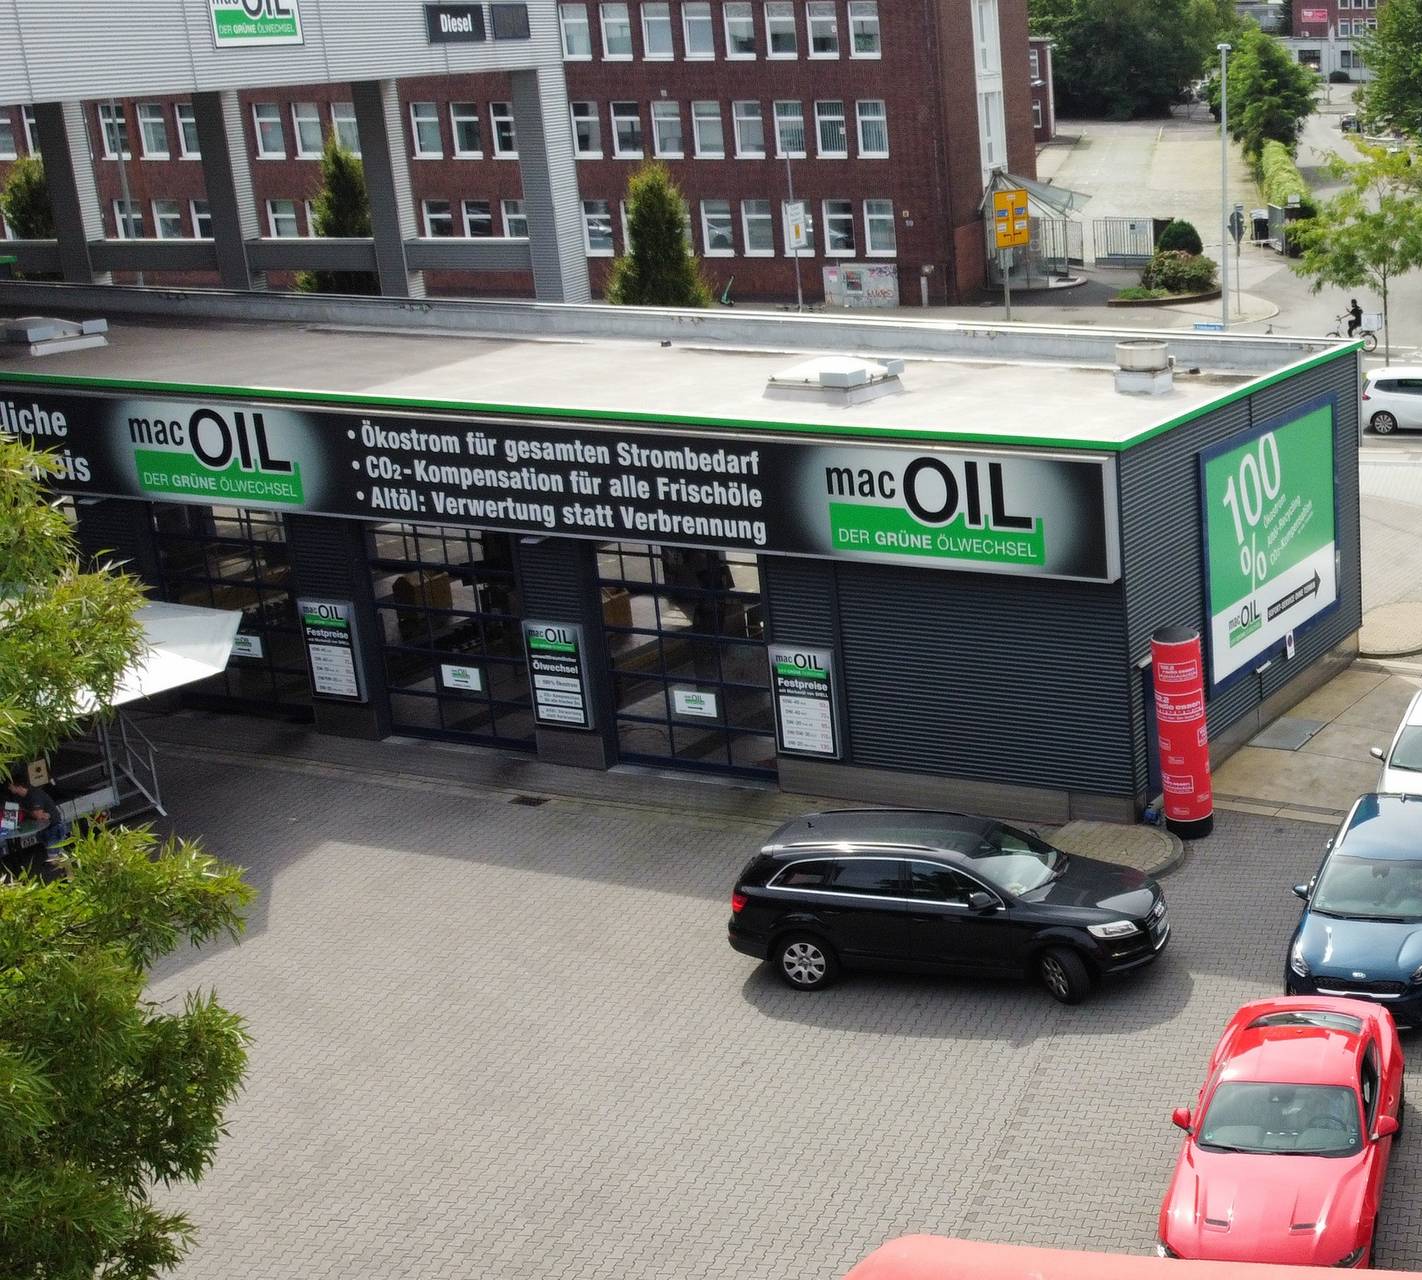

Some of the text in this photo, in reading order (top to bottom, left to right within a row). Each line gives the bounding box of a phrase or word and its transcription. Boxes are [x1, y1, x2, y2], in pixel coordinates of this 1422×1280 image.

[440, 13, 473, 32] Diesel
[128, 408, 293, 473] mac OIL
[361, 419, 760, 476] Ökostrom für gesamten Strombedarf
[143, 471, 298, 498] DER GRÜNE ÖLWECHSEL
[569, 469, 601, 496] für
[609, 474, 651, 501] alle
[656, 477, 763, 509] Frischöle
[825, 456, 1033, 529] mac OIL
[1223, 431, 1281, 546] 100
[371, 486, 767, 546] Altöl: Verwertung statt Verbrennung
[838, 528, 1038, 559] DER GRÜNE ÖLWECHSEL
[318, 605, 344, 620] OIL
[1241, 600, 1260, 628] OIL
[306, 627, 349, 639] Festpreise
[528, 628, 573, 645] mac OIL
[532, 659, 579, 675] Ölwechsel
[776, 653, 823, 671] mac OIL
[778, 678, 828, 692] Festpreise
